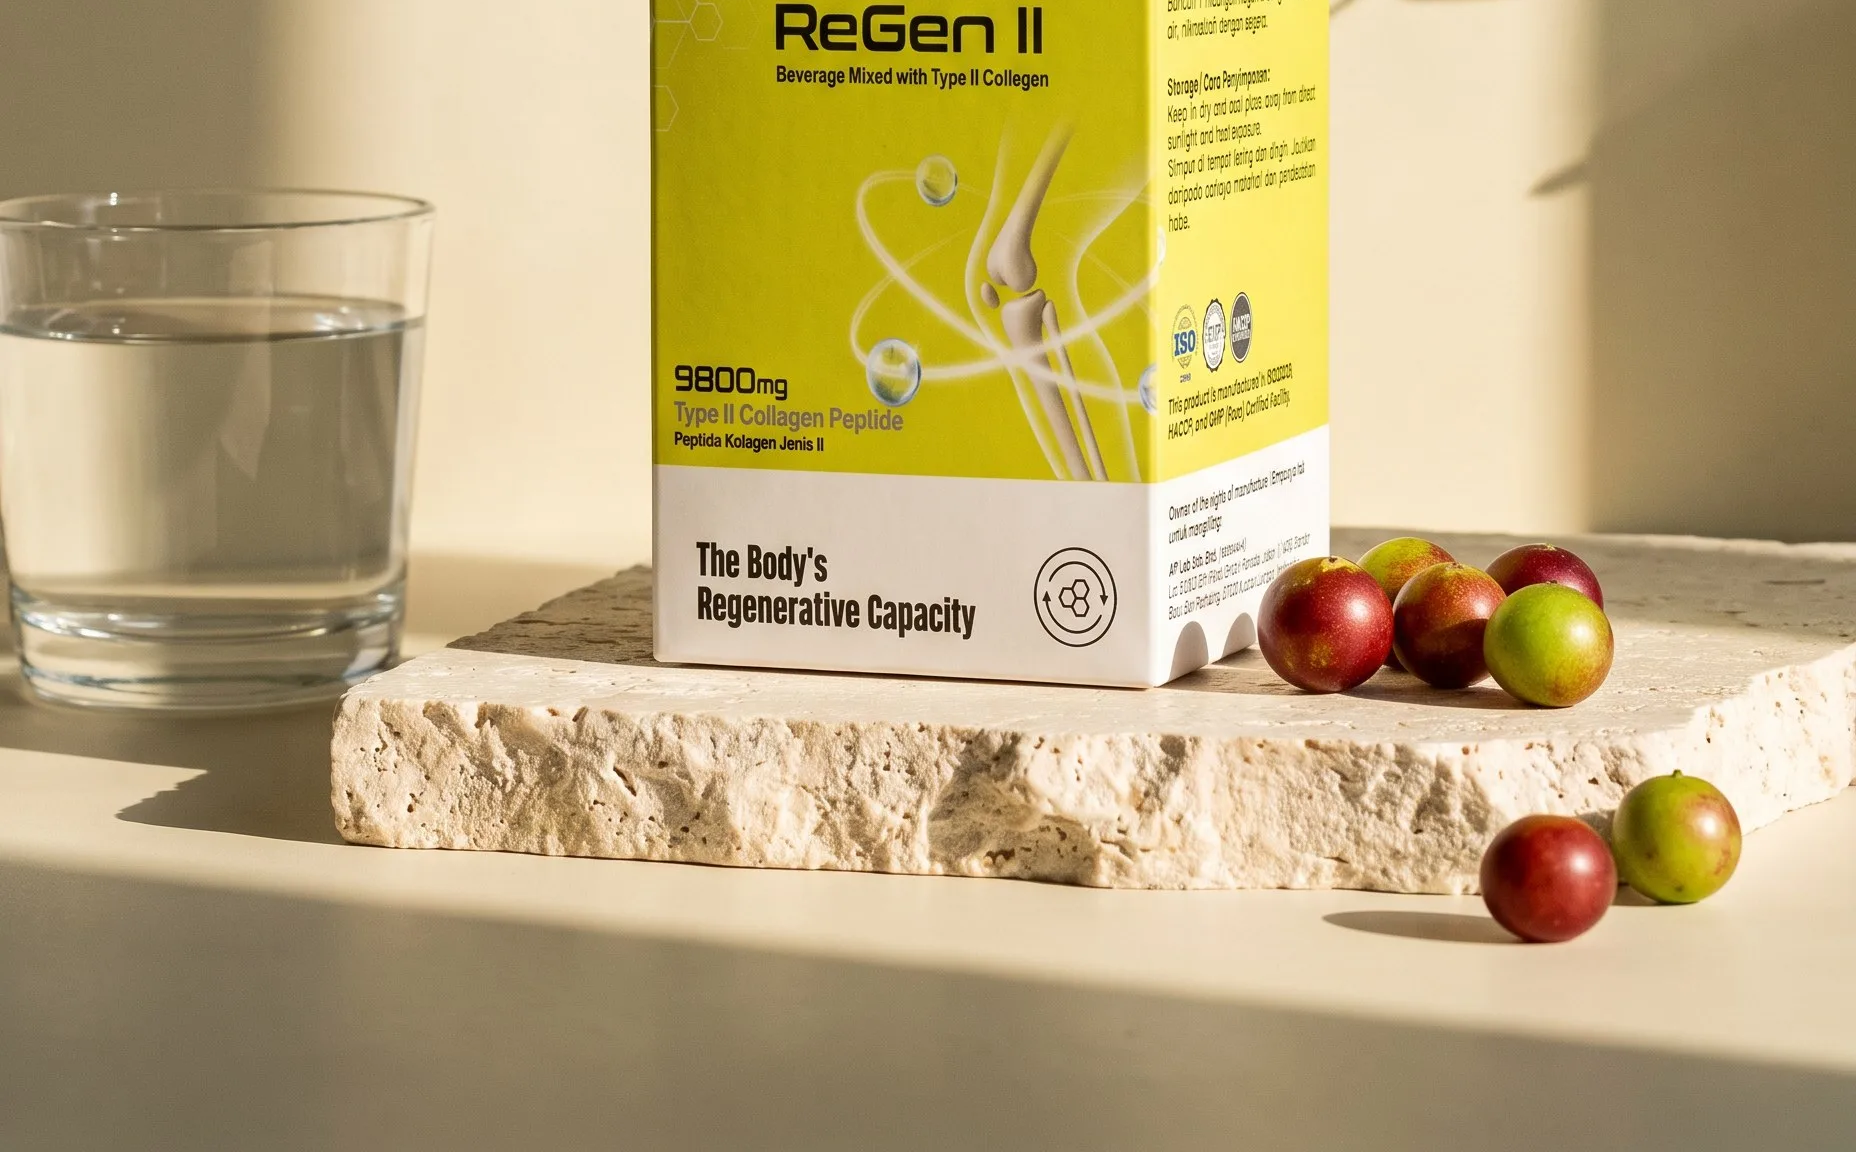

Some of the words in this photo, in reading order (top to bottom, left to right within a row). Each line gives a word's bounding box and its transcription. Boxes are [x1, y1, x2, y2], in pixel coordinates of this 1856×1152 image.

[776, 3, 994, 53] ReGen
[1018, 7, 1042, 54] II
[776, 65, 845, 87] Beverage
[849, 66, 892, 85] Mixed
[896, 68, 927, 85] with
[931, 68, 965, 89] Type
[983, 69, 1049, 91] Collegen
[1174, 330, 1196, 357] ISO
[675, 365, 788, 400] 9800mg
[674, 401, 719, 428] Type
[740, 404, 824, 432] Collagen
[829, 408, 903, 435] Peptide
[674, 432, 721, 450] Peptida
[725, 434, 776, 453] Kolagen
[779, 437, 813, 451] Jenis
[696, 542, 740, 578] The
[748, 544, 828, 587] Body's
[698, 586, 860, 628] Regenerative
[868, 594, 976, 640] Capacity
